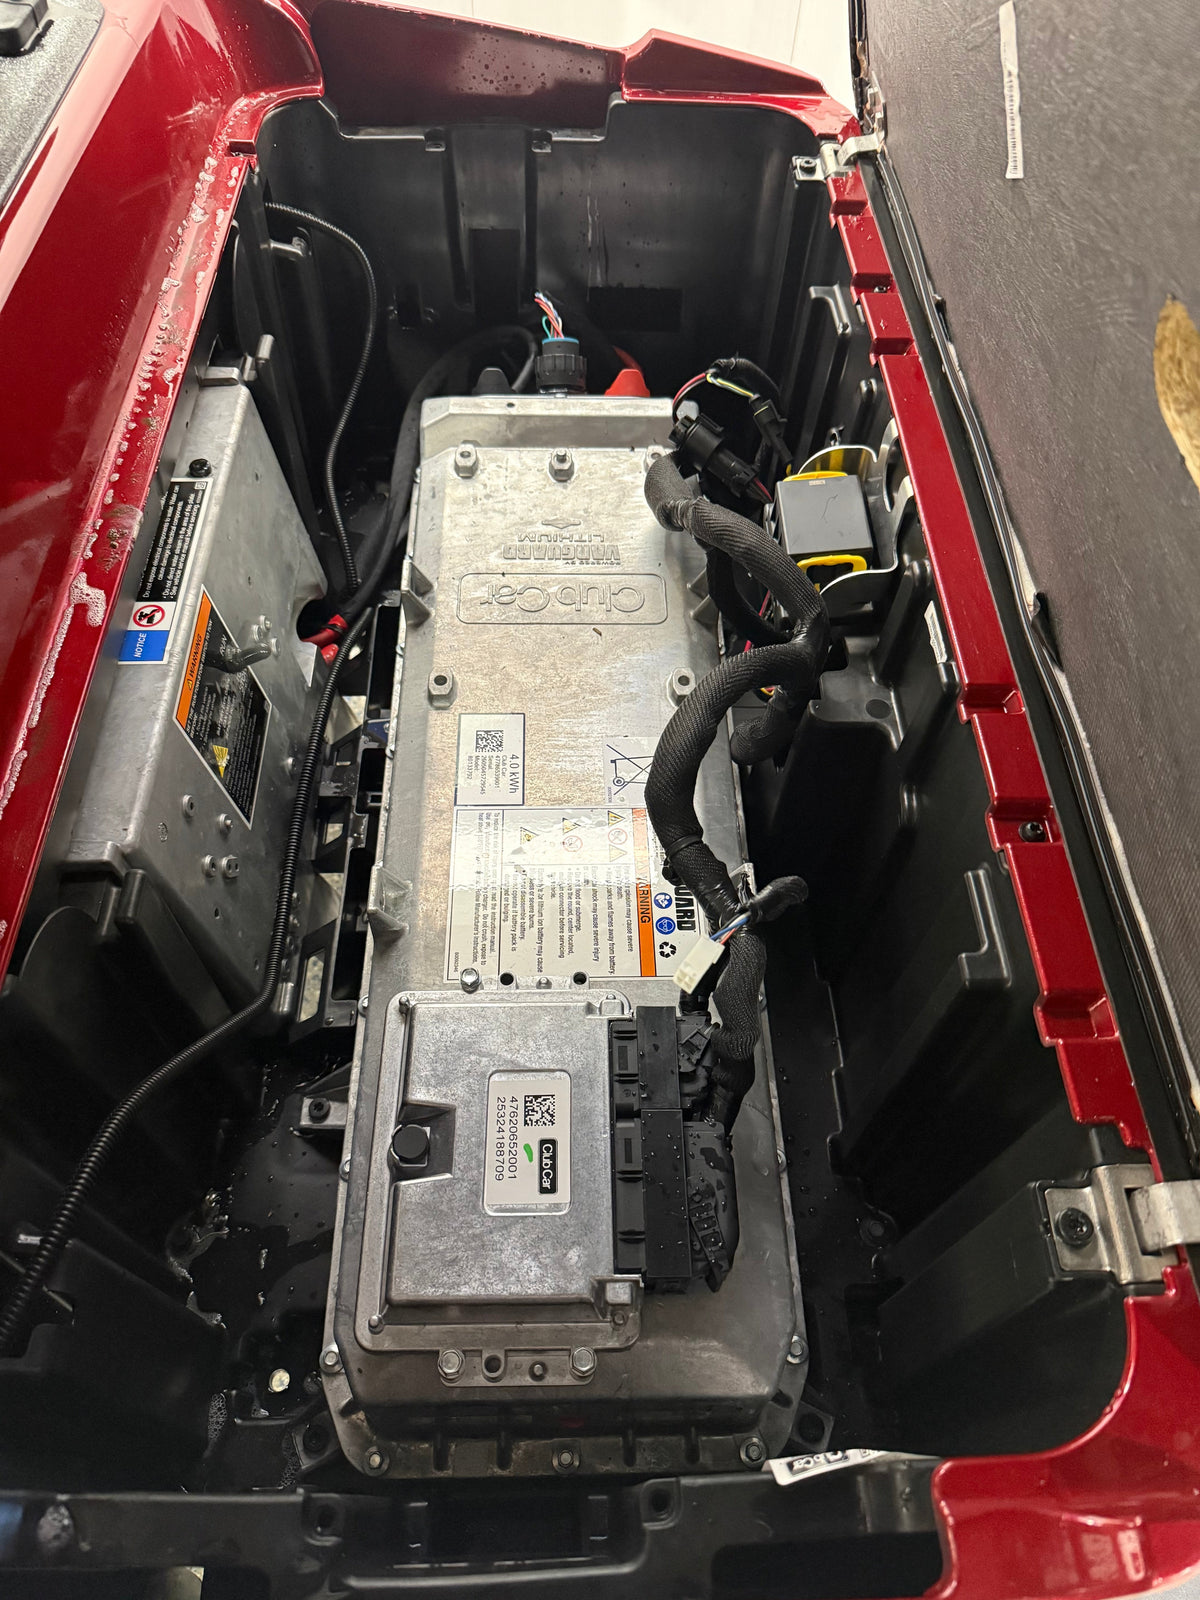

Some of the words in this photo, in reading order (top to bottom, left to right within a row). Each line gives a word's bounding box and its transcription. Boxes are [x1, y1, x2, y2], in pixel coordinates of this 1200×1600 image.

[517, 534, 605, 543] LITHIUM
[502, 545, 620, 560] VANGUARD
[169, 585, 178, 595] See
[480, 584, 551, 613] Car
[556, 584, 645, 613] Club
[134, 633, 147, 657] NOTICE
[189, 633, 202, 678] WARNING
[509, 754, 519, 768] 4.0
[509, 772, 519, 794] kWh
[674, 886, 696, 931] UARD
[536, 927, 544, 945] battery
[495, 1096, 506, 1181] 25324188709
[508, 1096, 518, 1180] 47620652001
[542, 1144, 553, 1169] Club
[542, 1170, 553, 1190] Car
